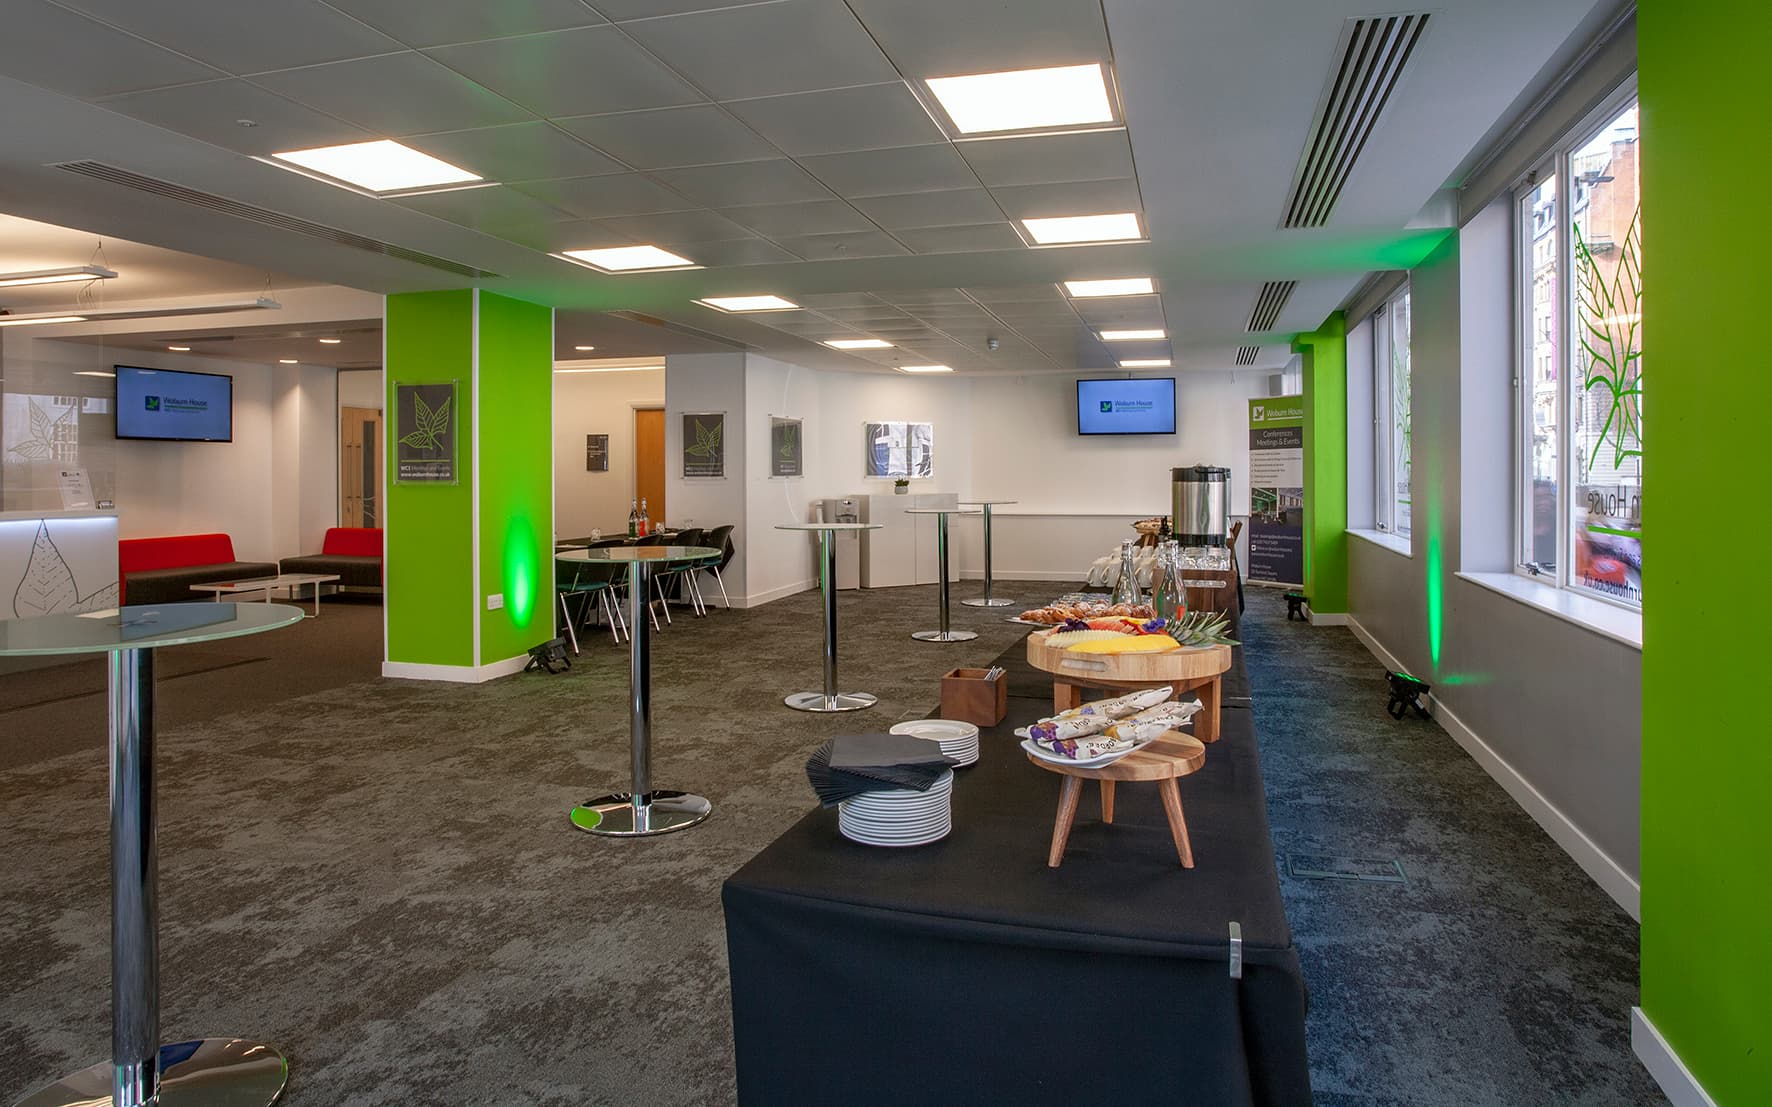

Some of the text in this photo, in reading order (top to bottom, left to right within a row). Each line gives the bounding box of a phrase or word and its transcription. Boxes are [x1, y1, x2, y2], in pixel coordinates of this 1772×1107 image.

[1267, 409, 1287, 417] Woburn
[1263, 430, 1293, 438] Conferences
[1257, 438, 1278, 448] Meetings
[1283, 437, 1300, 446] Events
